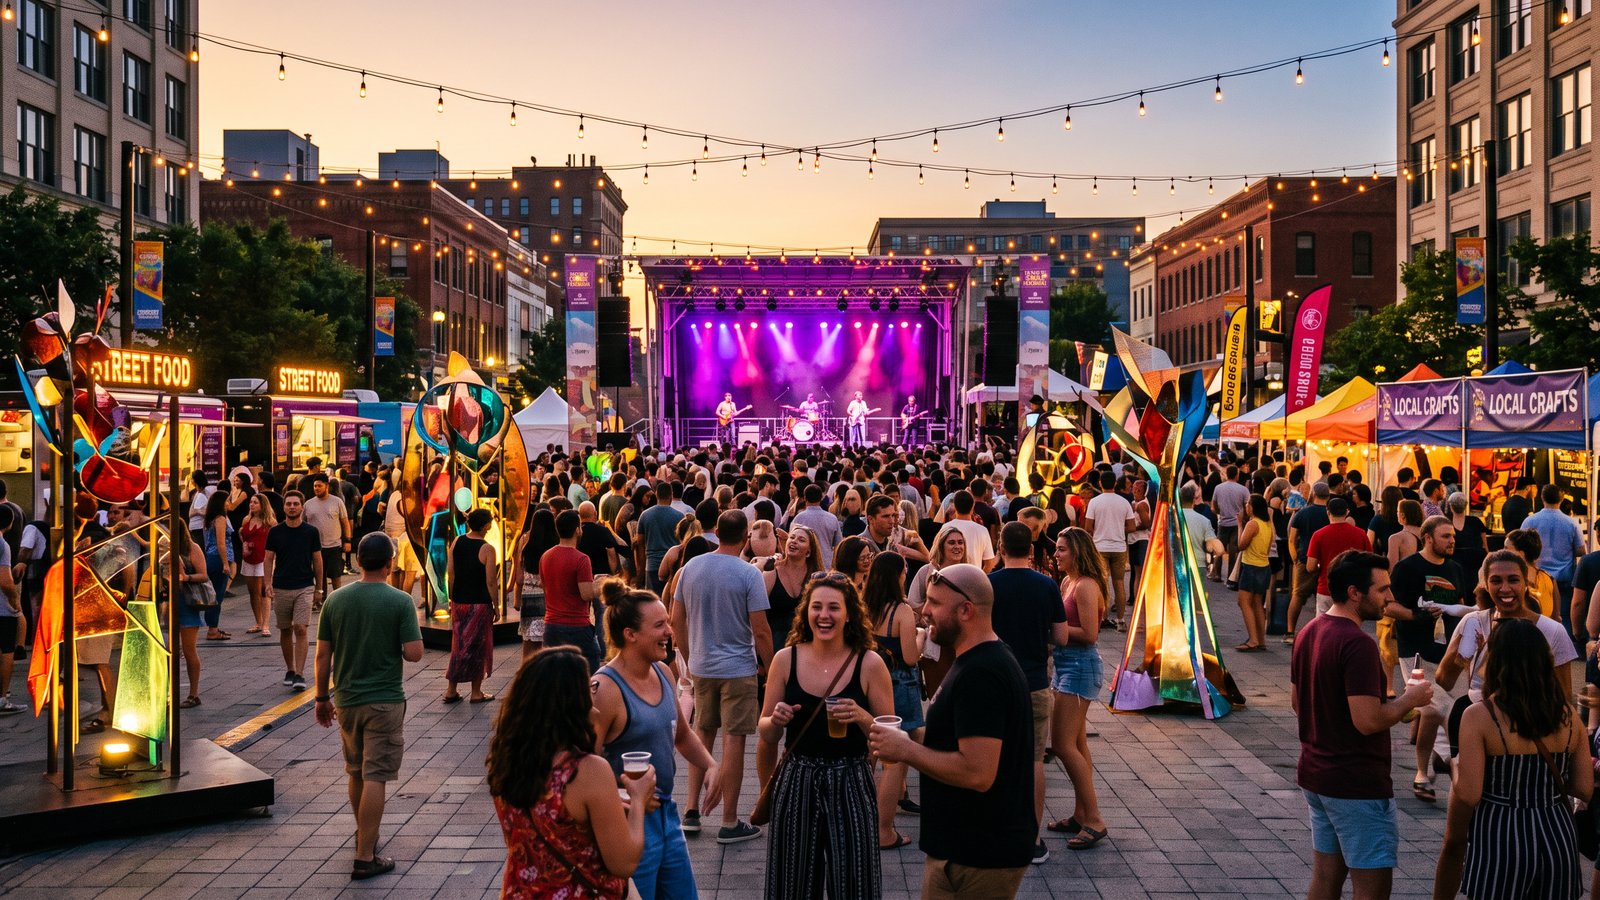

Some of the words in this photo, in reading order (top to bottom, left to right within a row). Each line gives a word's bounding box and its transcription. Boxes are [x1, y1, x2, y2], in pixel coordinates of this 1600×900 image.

[153, 355, 191, 387] FOOD
[280, 367, 315, 392] STREET
[317, 370, 340, 393] FOOD
[1394, 397, 1422, 416] LOCAL
[1424, 394, 1460, 415] CRAFTS
[1489, 393, 1526, 415] LOCAL
[1529, 388, 1578, 414] CRAFTS
